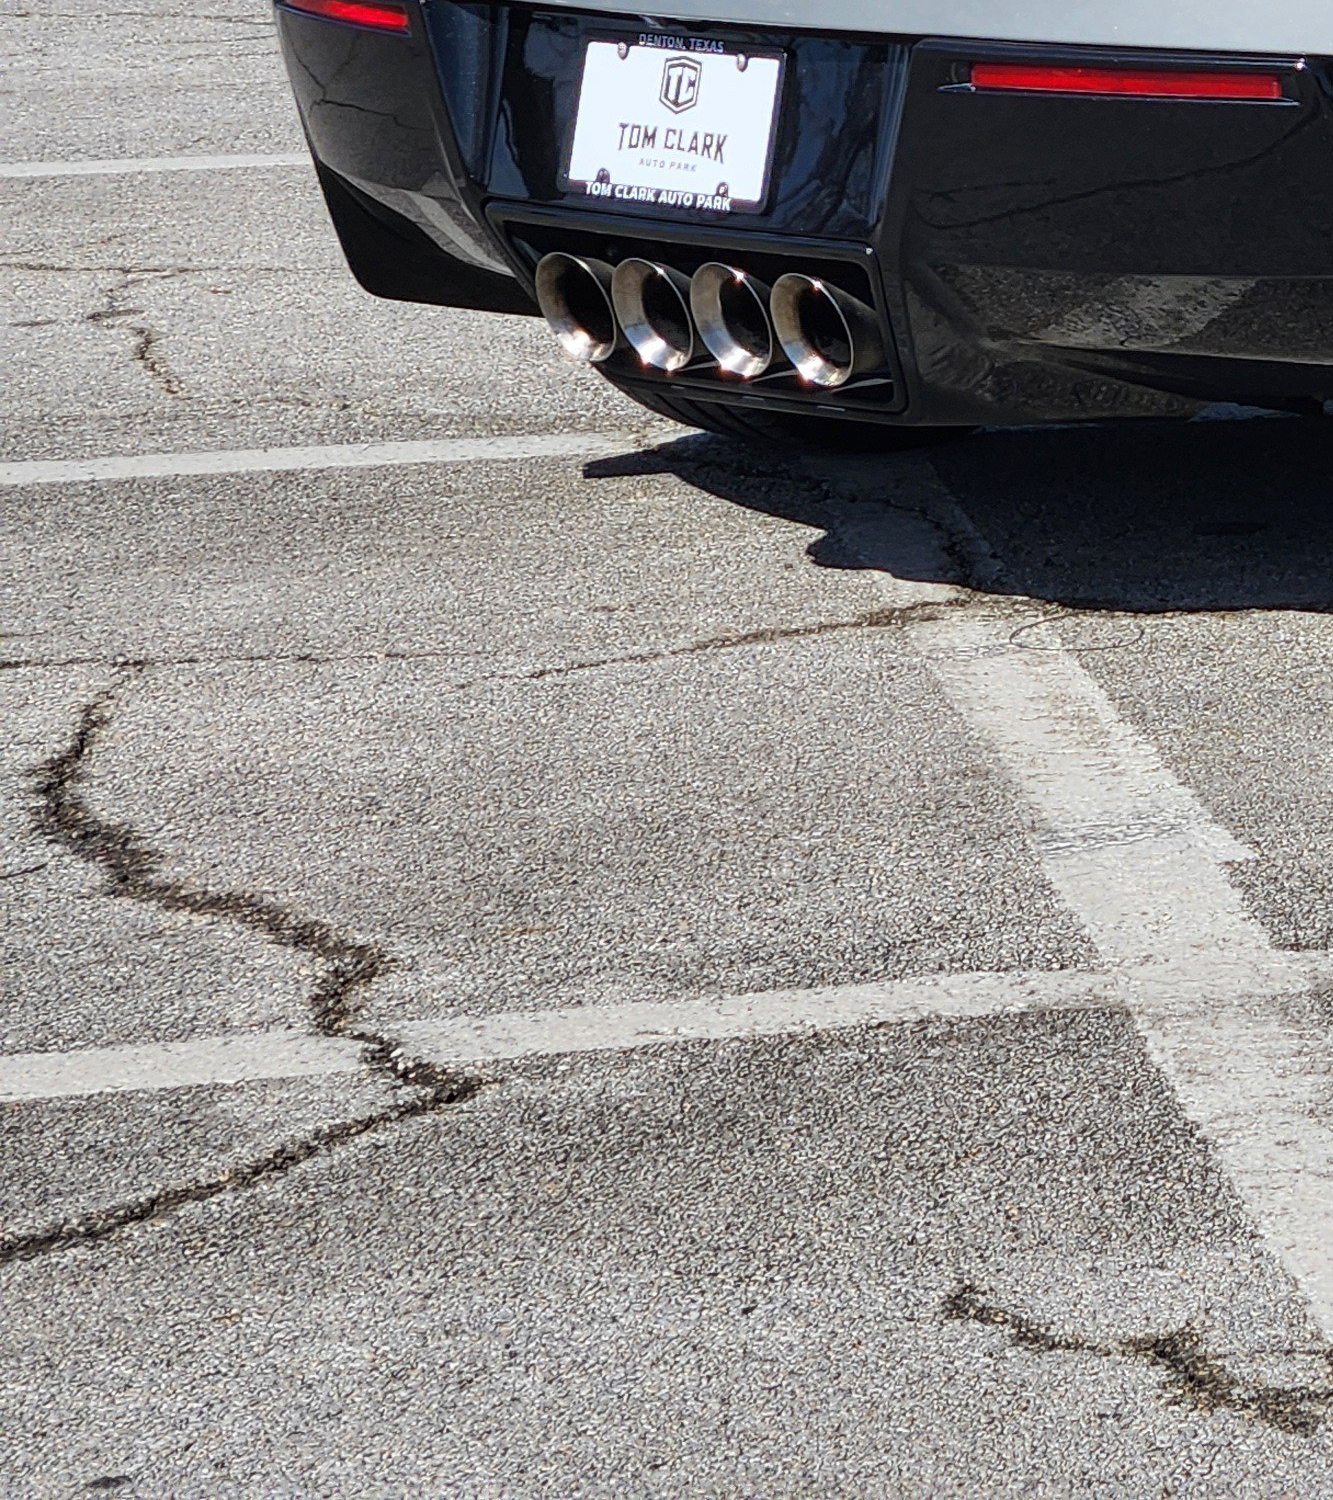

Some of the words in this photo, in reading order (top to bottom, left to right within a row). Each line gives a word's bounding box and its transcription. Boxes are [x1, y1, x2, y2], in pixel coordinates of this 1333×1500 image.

[638, 33, 686, 50] DENTON,
[688, 37, 724, 53] TEXAS
[618, 122, 658, 151] TOM
[664, 127, 729, 164] CLARK
[639, 158, 666, 169] AUTO
[669, 161, 698, 172] PARK
[585, 181, 612, 197] TOM
[614, 184, 656, 202] CLARK
[657, 190, 693, 206] AUTO
[696, 195, 732, 211] PARK
